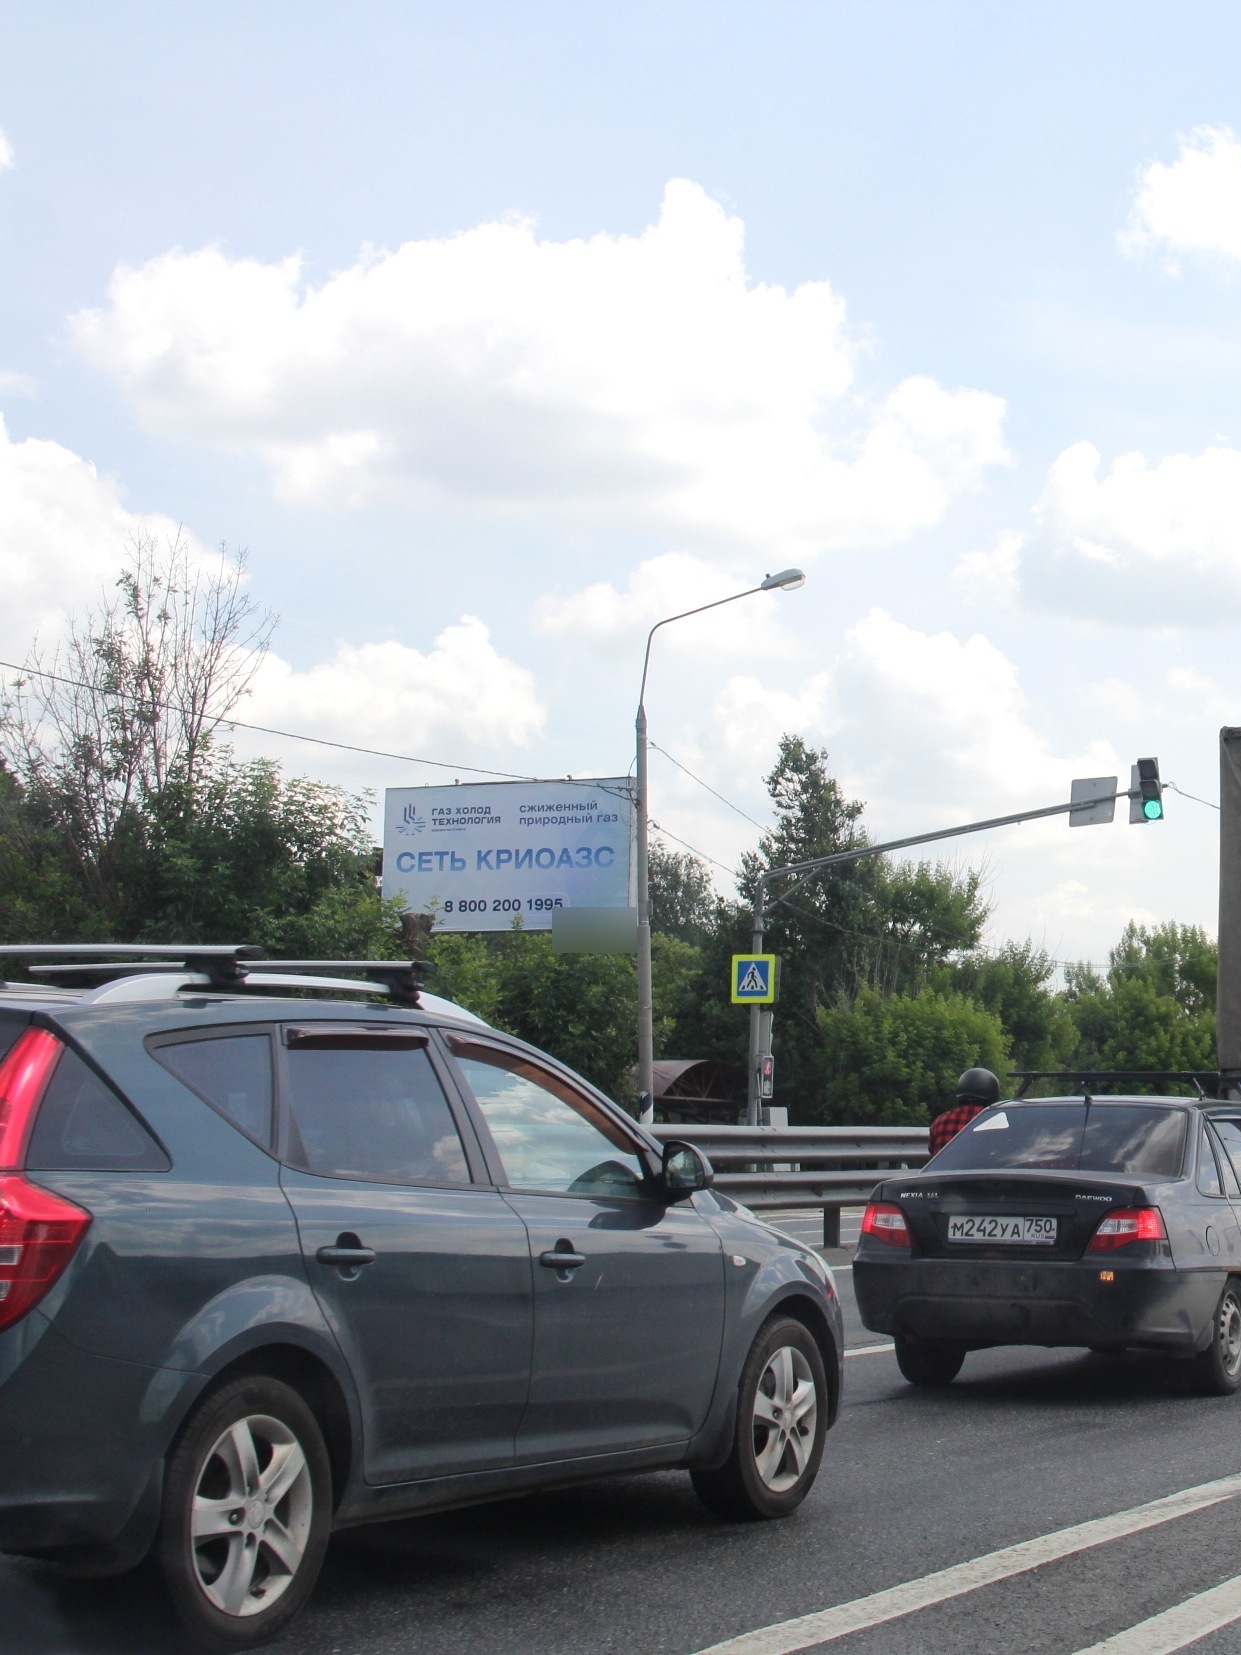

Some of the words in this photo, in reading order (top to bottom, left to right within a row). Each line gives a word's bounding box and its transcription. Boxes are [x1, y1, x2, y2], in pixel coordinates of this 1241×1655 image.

[431, 807, 452, 816] ГАЗ
[456, 806, 492, 816] ХОЛОД
[519, 800, 598, 813] сжиженный
[431, 816, 502, 826] ТЕХНОЛОГИЯ
[519, 813, 593, 827] природный
[597, 814, 618, 823] газ
[396, 851, 467, 873] СЕТЬ
[476, 846, 615, 871] КРИОАЗС
[444, 900, 454, 913] 8
[458, 900, 487, 913] 800
[492, 899, 521, 912] 200
[526, 898, 563, 911] 1995
[1075, 1194, 1113, 1203] DAEWOO
[1025, 1217, 1053, 1233] 750
